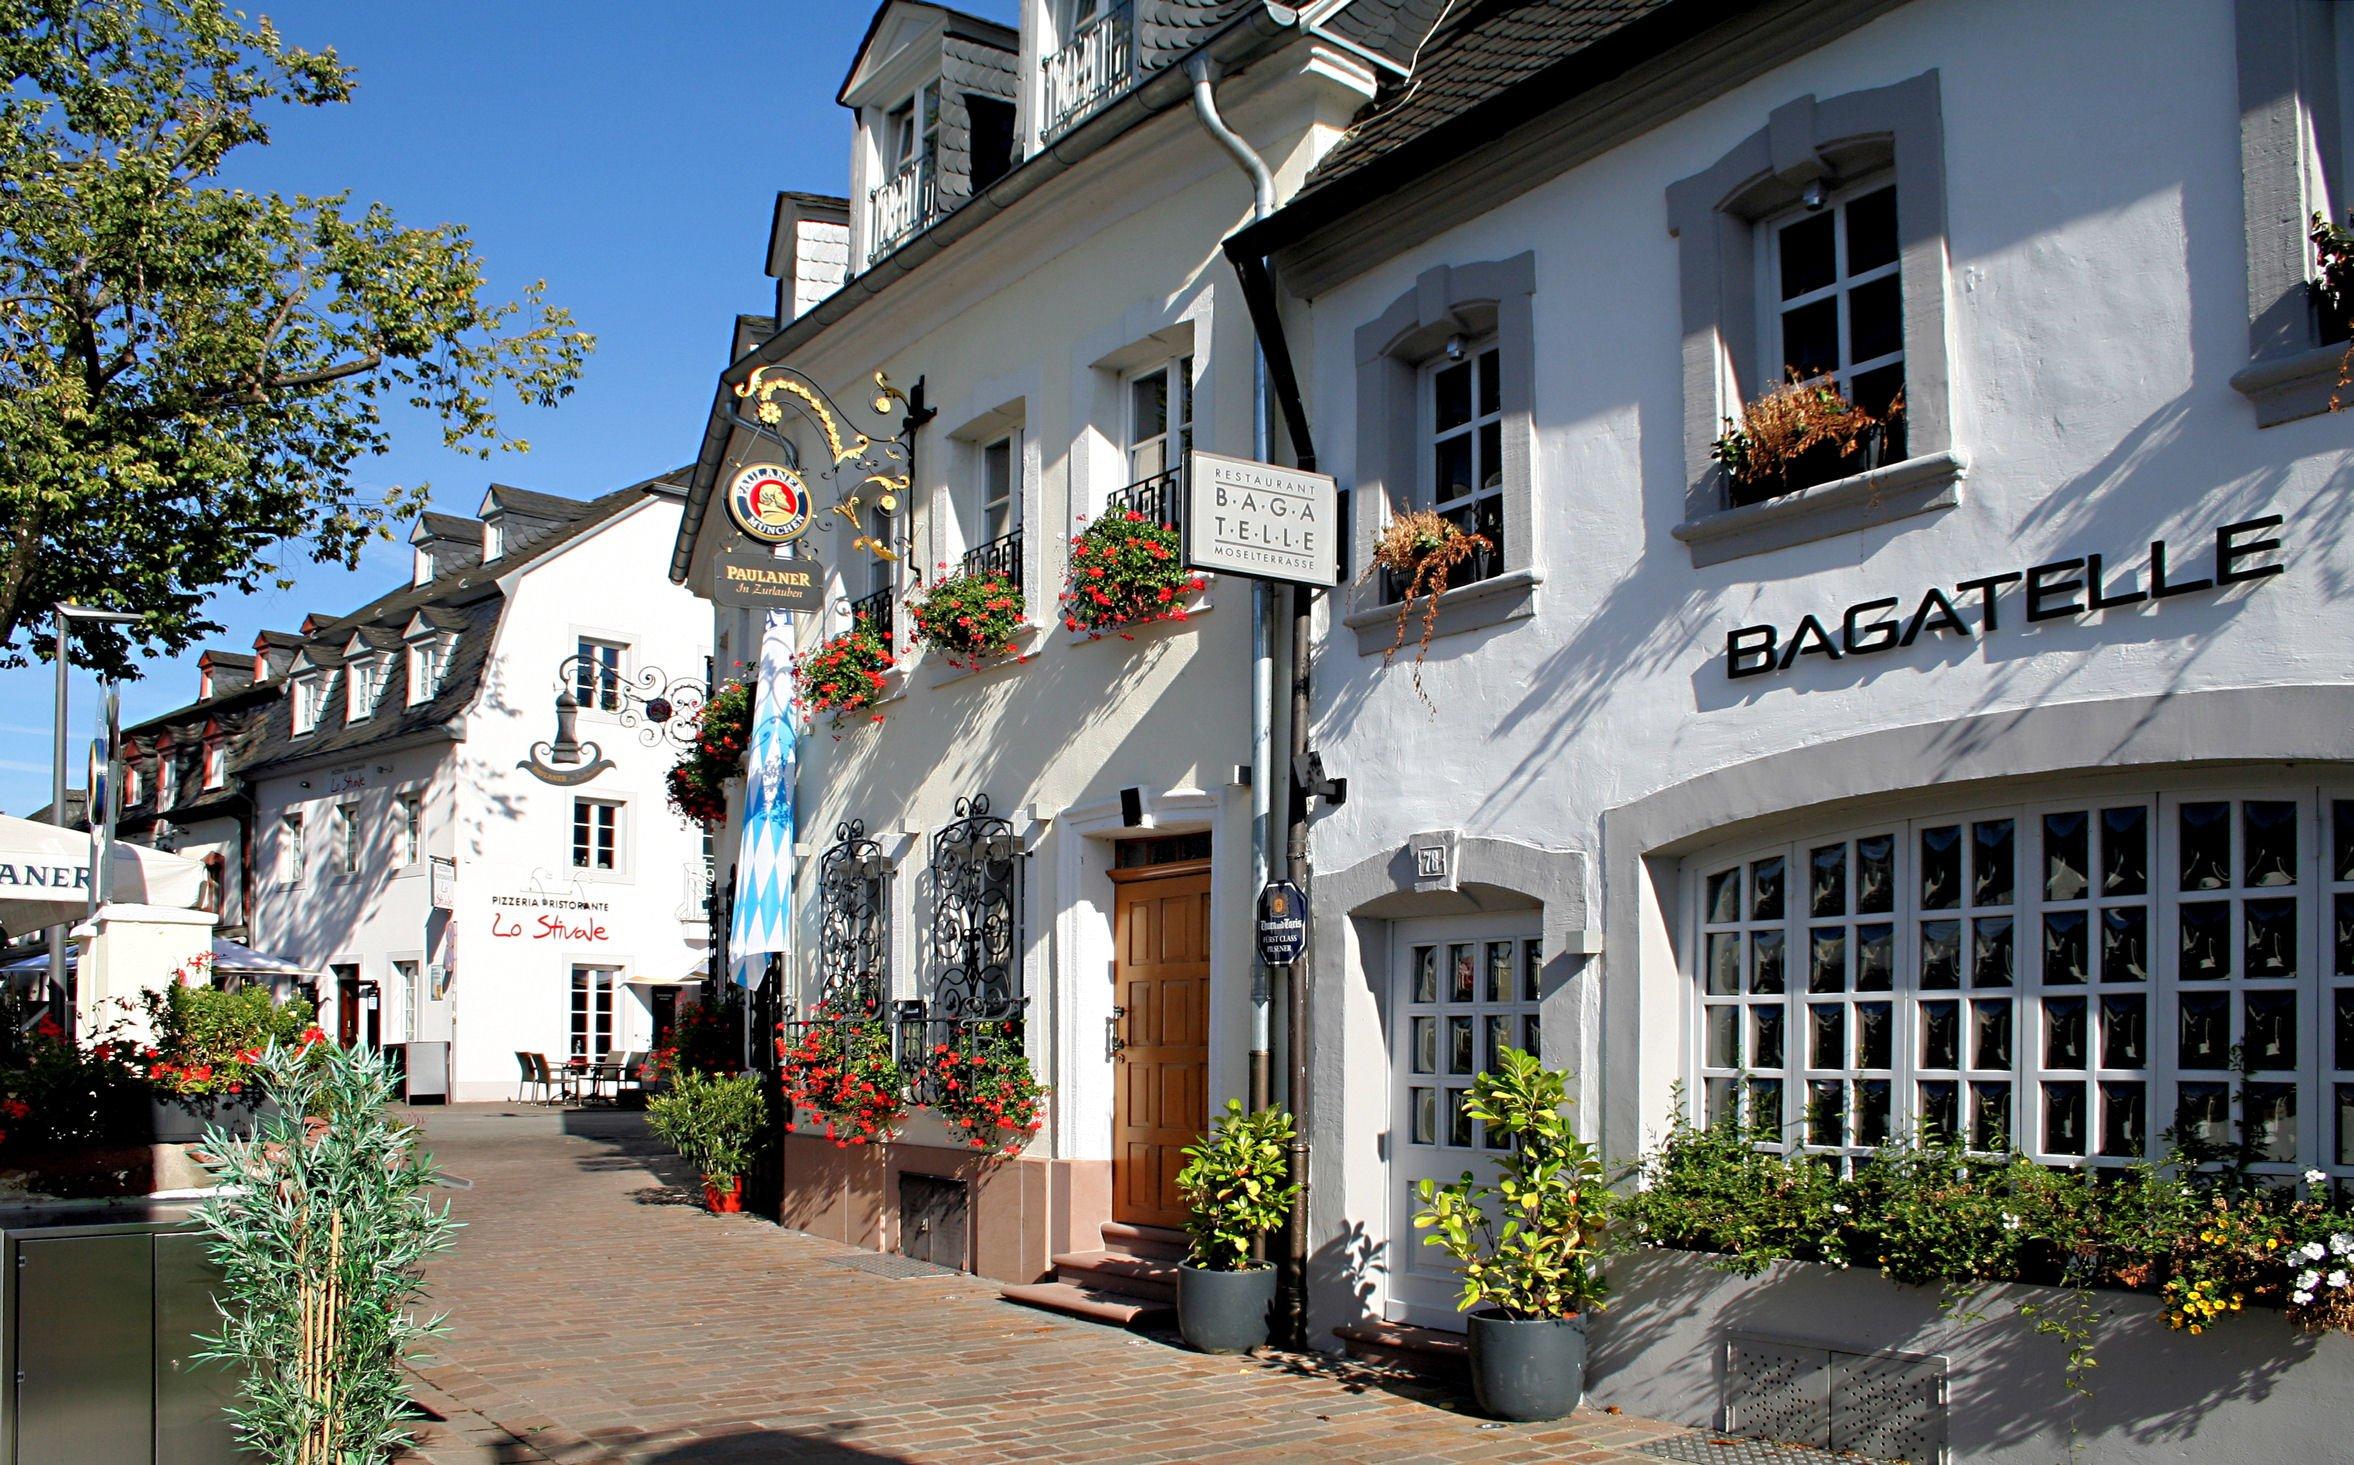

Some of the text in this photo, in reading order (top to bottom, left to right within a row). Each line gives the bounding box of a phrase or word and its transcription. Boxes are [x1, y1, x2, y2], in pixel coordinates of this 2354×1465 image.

[736, 468, 804, 497] PAULANER
[1215, 468, 1315, 495] RESTAURANT
[1214, 545, 1315, 570] MOSELTERRASSE
[726, 565, 812, 588] PAULANER
[752, 583, 803, 598] Zurlauben
[1726, 514, 2284, 680] BAGATELLE
[1421, 850, 1440, 873] 78
[492, 896, 539, 907] PIZZERIA
[492, 912, 609, 942] Lo Stivale
[1267, 945, 1292, 953] PILSENER
[1279, 935, 1298, 943] CLASS
